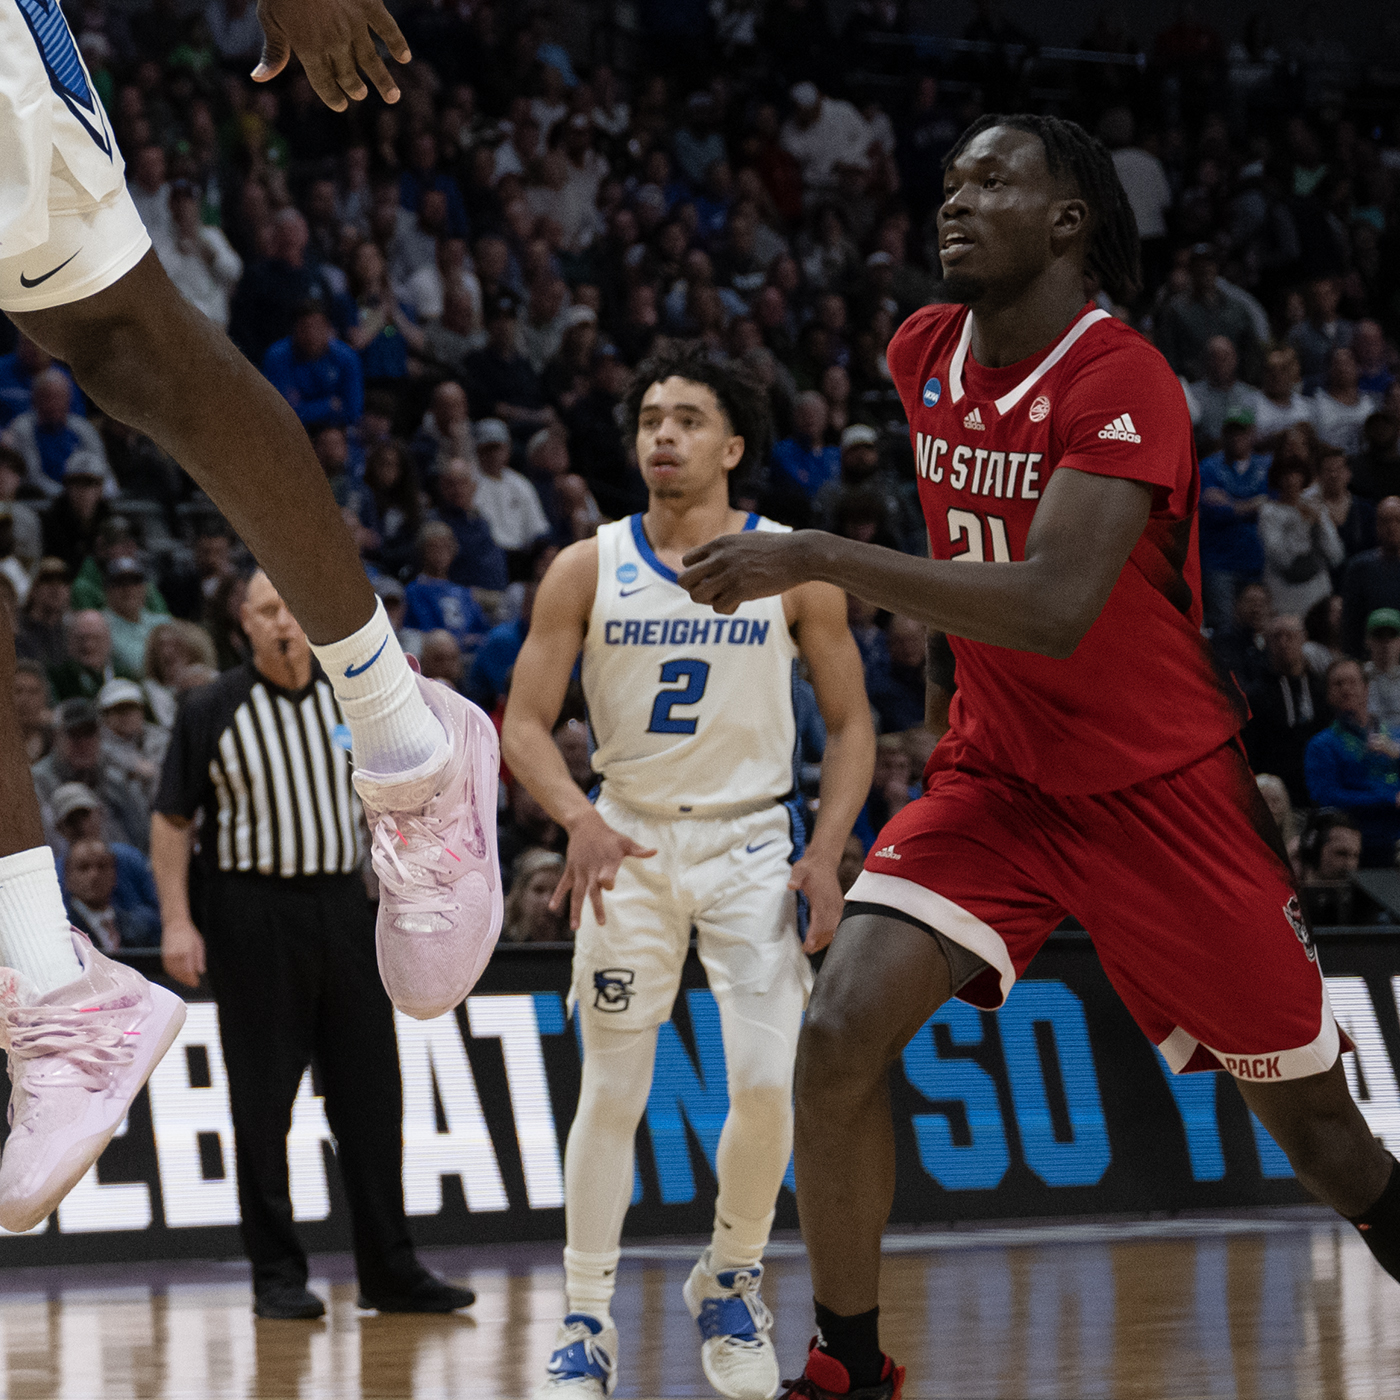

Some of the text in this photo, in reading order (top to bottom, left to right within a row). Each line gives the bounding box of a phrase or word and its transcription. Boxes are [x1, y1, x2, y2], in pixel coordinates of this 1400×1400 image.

[1098, 429, 1142, 444] adidas
[916, 431, 1043, 500] NC STATE
[604, 618, 770, 646] CREIGHTON
[645, 657, 711, 735] 2
[1226, 1056, 1282, 1079] PACK
